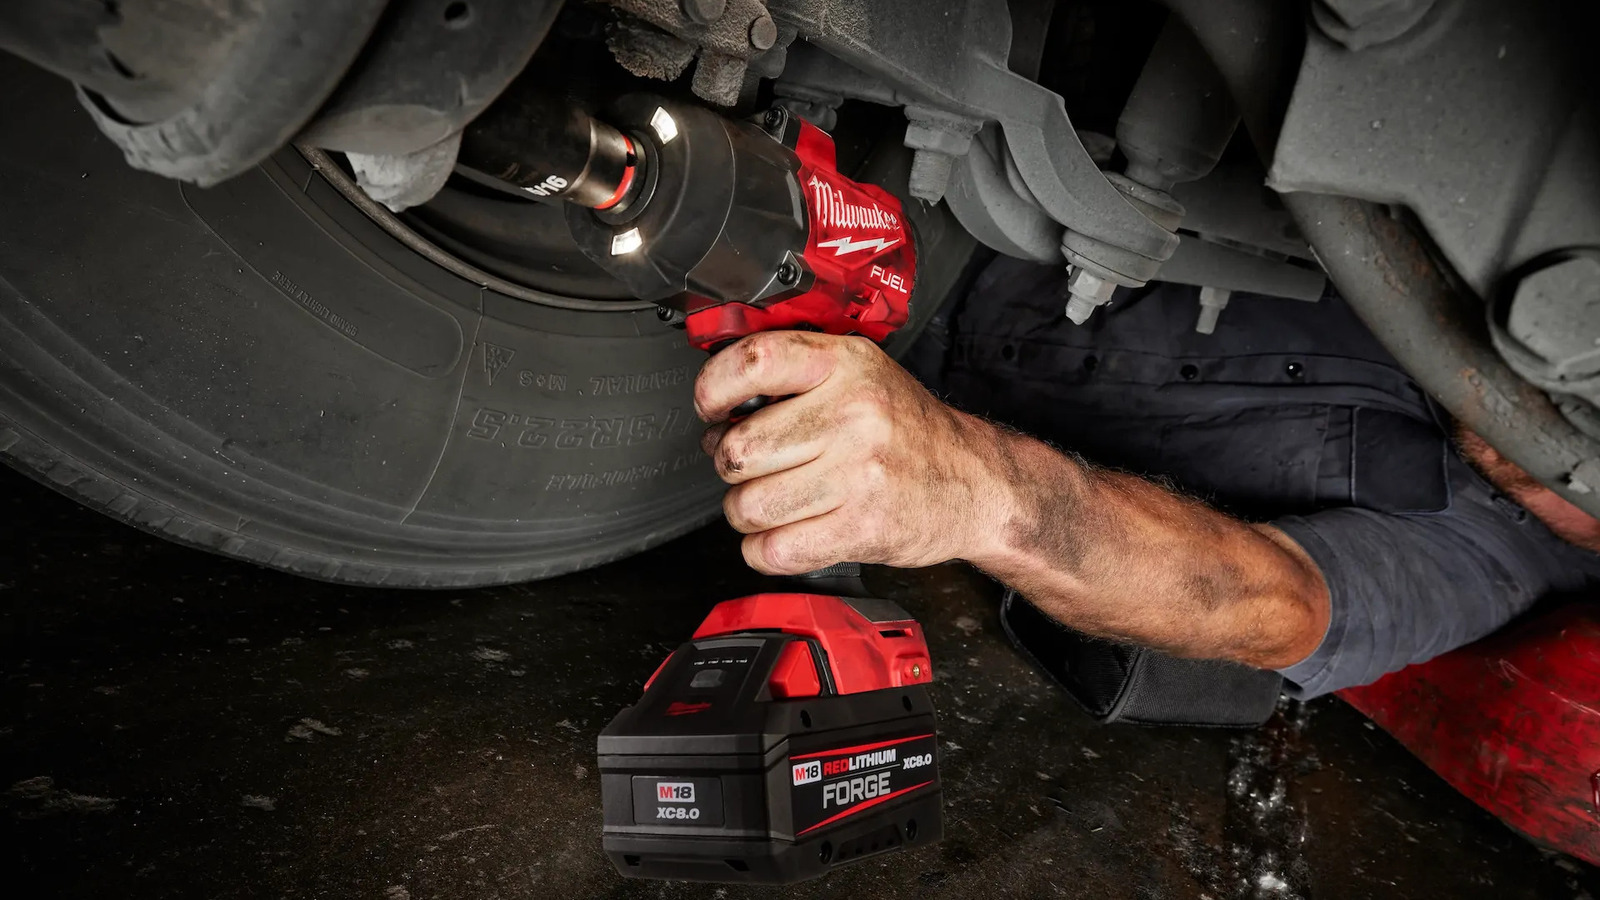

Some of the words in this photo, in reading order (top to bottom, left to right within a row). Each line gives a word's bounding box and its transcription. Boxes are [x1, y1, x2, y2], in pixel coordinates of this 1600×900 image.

[809, 174, 900, 230] Milwaukee
[870, 265, 907, 293] FUEL
[795, 765, 819, 781] M18
[903, 753, 932, 770] XC8.0
[659, 786, 692, 799] M18
[823, 771, 891, 809] FORGE
[656, 807, 700, 820] XC8.0
